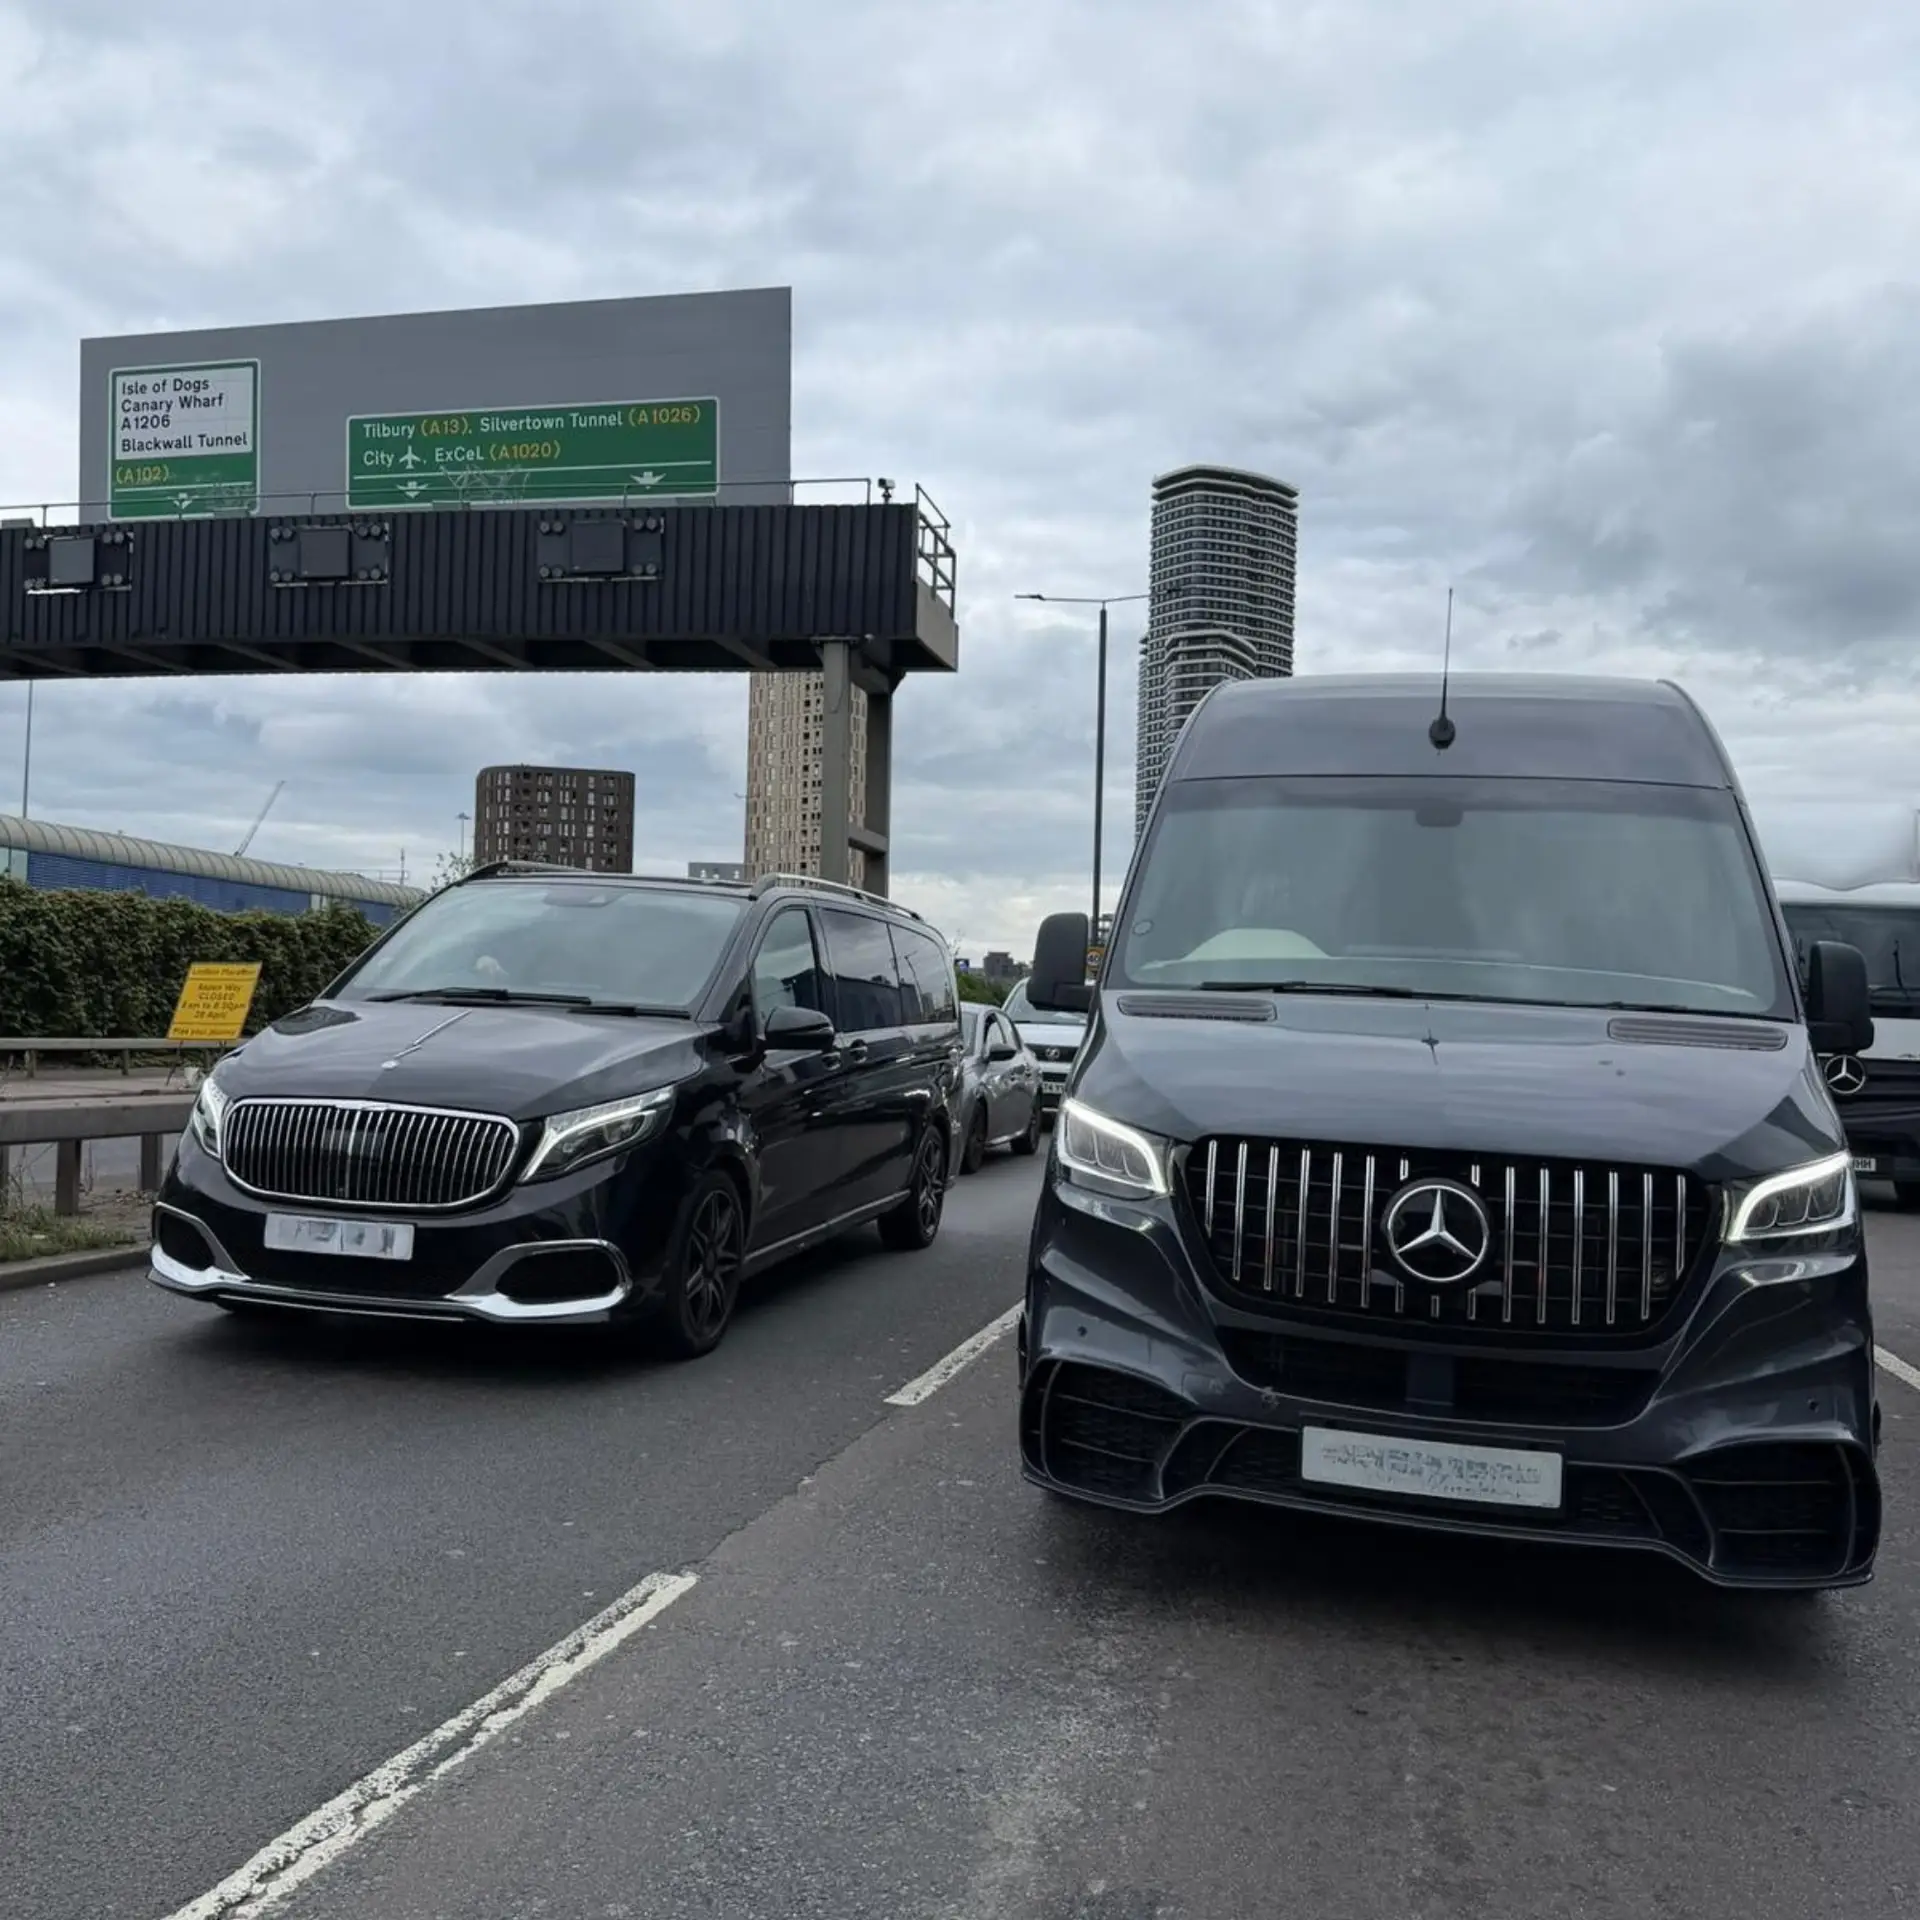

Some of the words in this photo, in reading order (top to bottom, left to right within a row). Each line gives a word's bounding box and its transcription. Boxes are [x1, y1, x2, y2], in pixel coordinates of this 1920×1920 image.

[122, 381, 148, 395] Isle
[152, 379, 167, 393] of
[172, 378, 210, 393] Dogs
[121, 399, 173, 413] Canary
[178, 392, 224, 409] Wharf
[121, 414, 171, 431] A1206
[363, 423, 415, 439] Tilbury
[480, 414, 564, 433] Silvertown
[569, 410, 623, 428] Tunnel
[121, 435, 193, 452] Blackwall
[197, 432, 248, 449] Tunnel
[363, 450, 395, 468] City
[434, 445, 484, 463] ExCeL
[489, 439, 561, 461] (A1020)
[116, 464, 169, 485] (A102)
